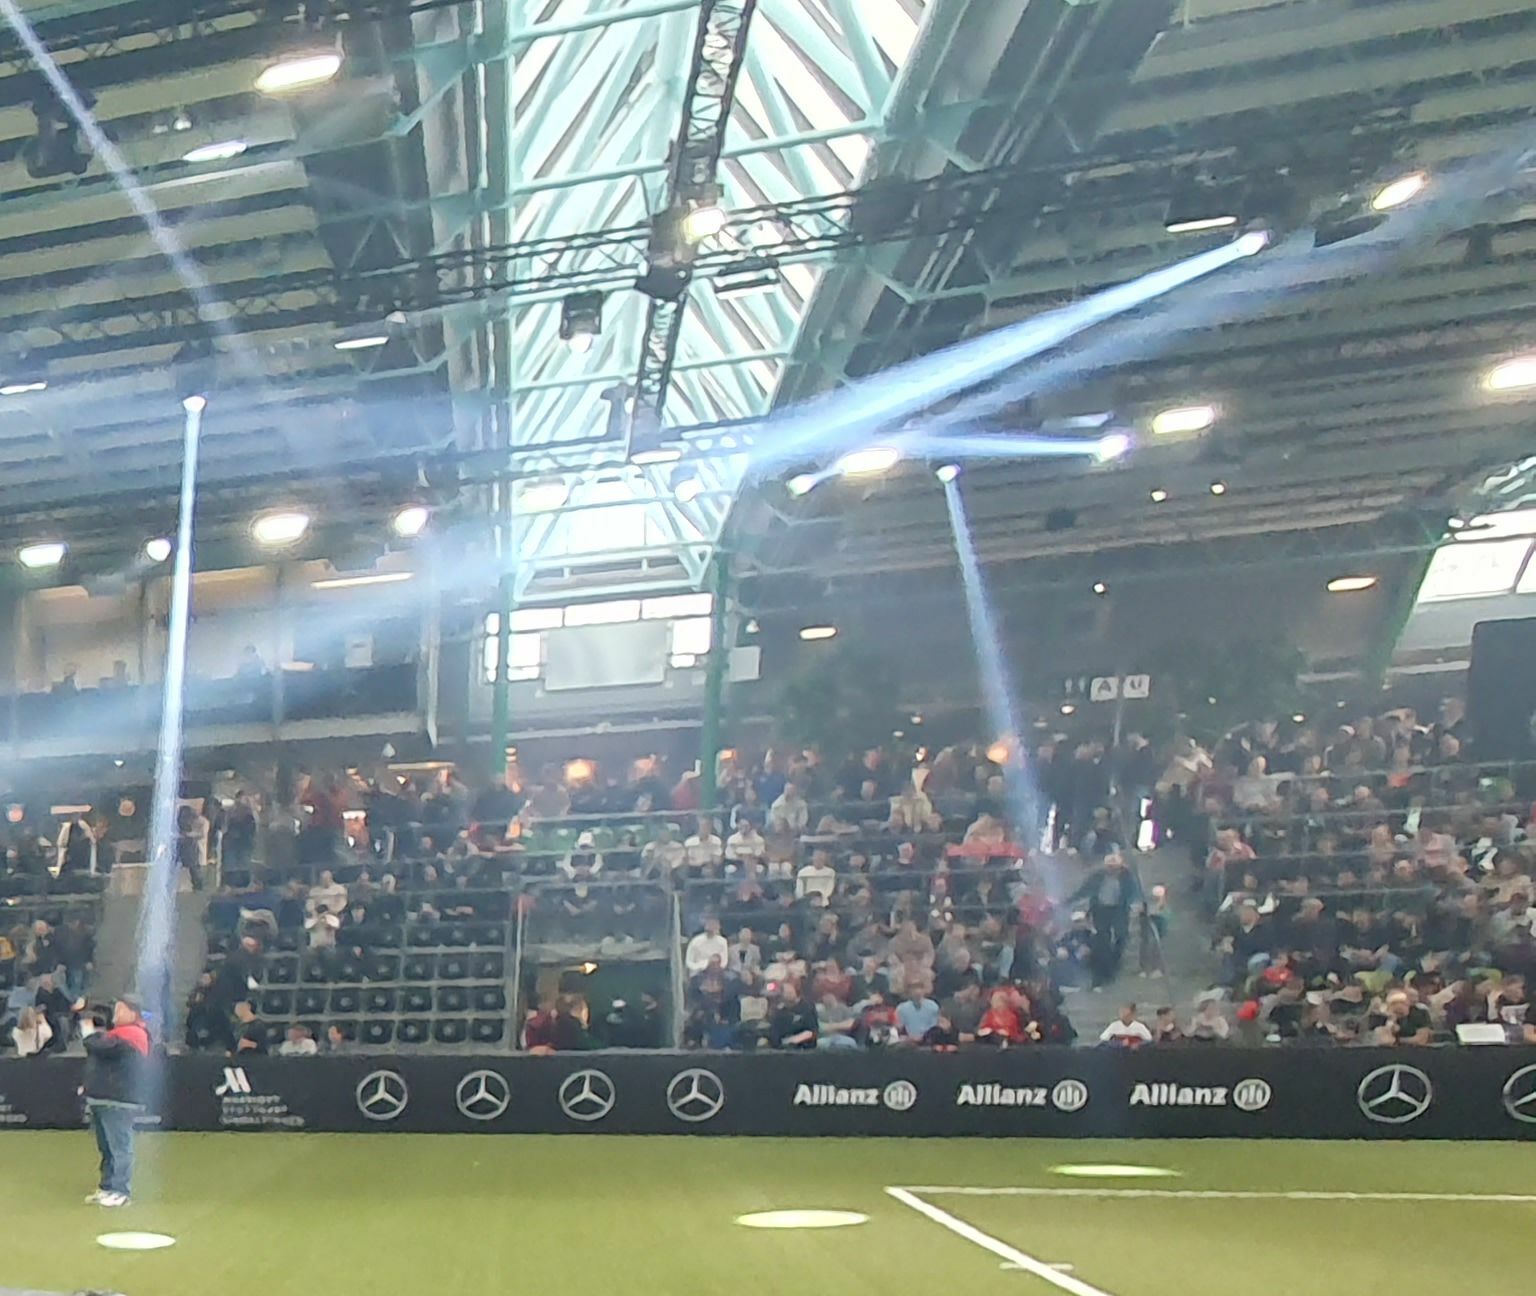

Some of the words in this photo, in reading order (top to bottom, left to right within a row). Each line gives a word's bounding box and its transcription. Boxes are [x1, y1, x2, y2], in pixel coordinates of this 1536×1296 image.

[792, 1083, 880, 1106] Allianz
[956, 1083, 1047, 1106] Allianz
[1128, 1083, 1228, 1106] Allianz
